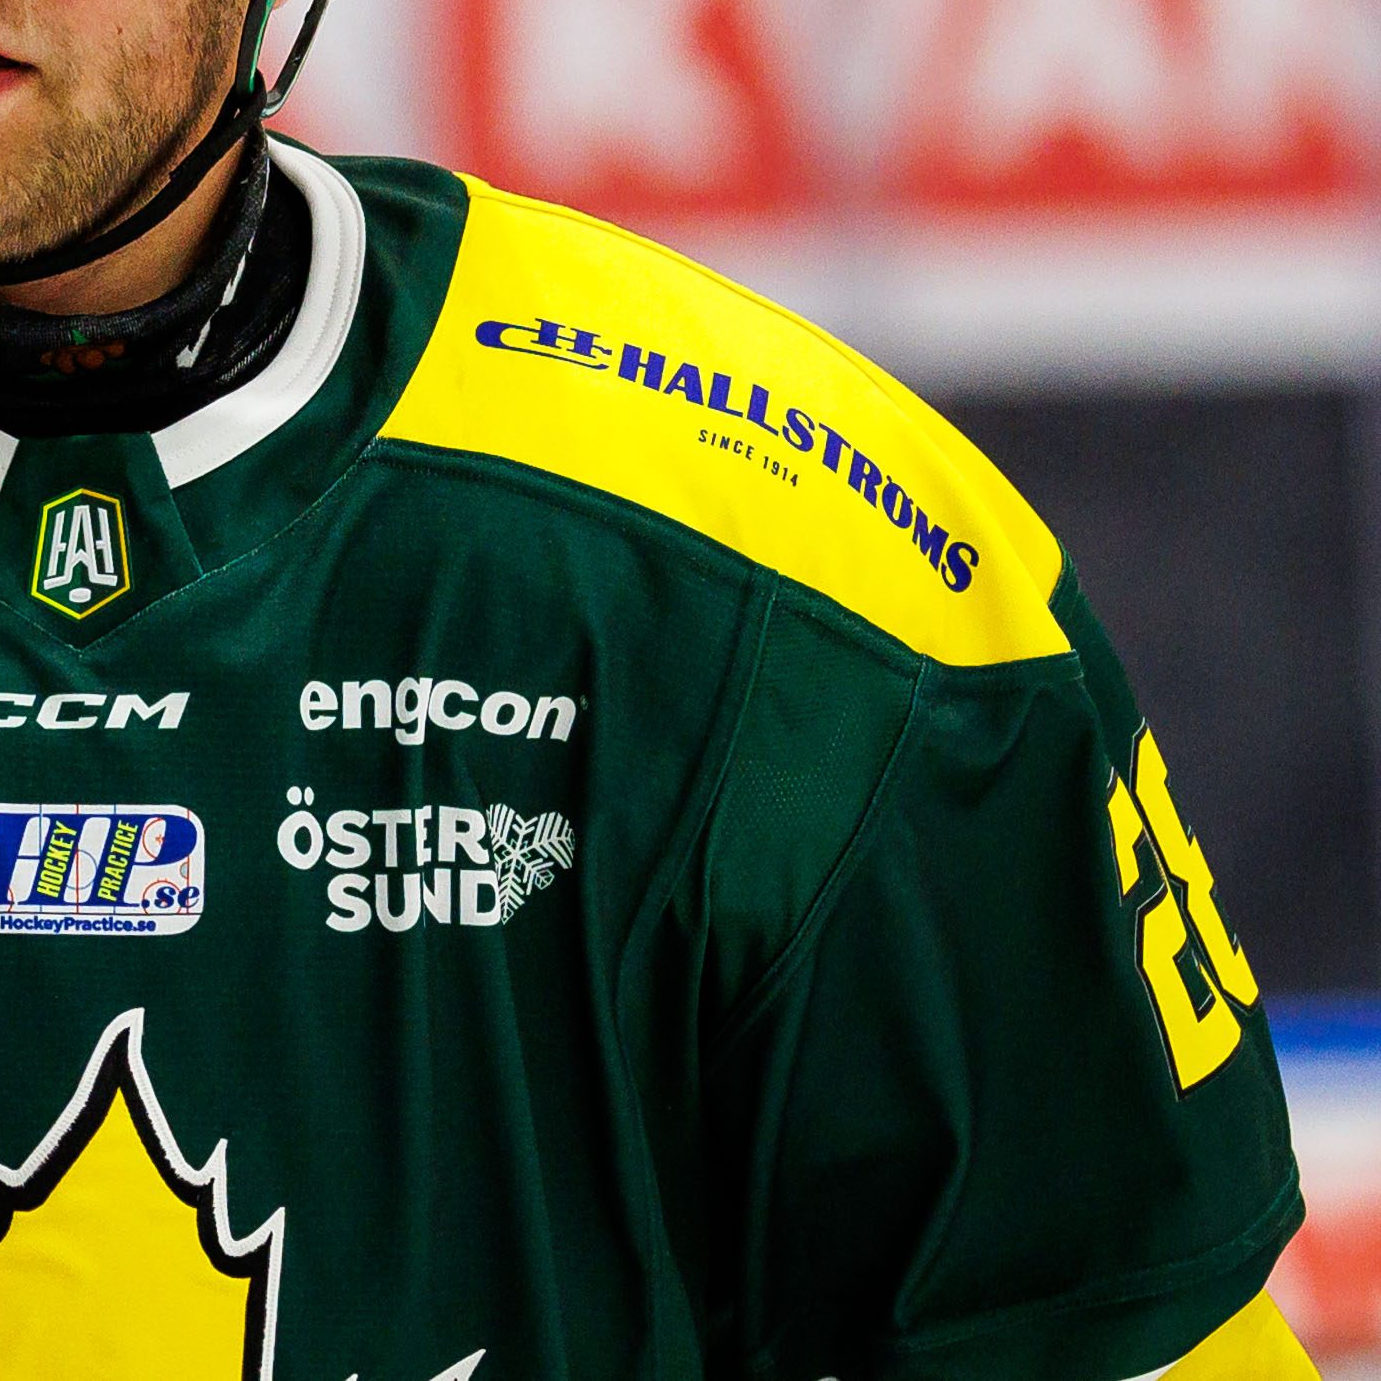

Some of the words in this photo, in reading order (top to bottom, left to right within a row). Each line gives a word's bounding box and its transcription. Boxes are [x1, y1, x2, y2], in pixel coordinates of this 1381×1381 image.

[617, 343, 979, 593] HALLSTRÖMS
[698, 429, 754, 461] SINCE
[762, 455, 800, 488] 1914
[299, 677, 577, 746] engcon
[36, 820, 78, 898] HOCKEY
[97, 819, 139, 902] PRACTICE
[277, 785, 490, 870] ÖSTER
[0, 915, 157, 934] HockeyPractice.se
[325, 868, 501, 933] SUND
